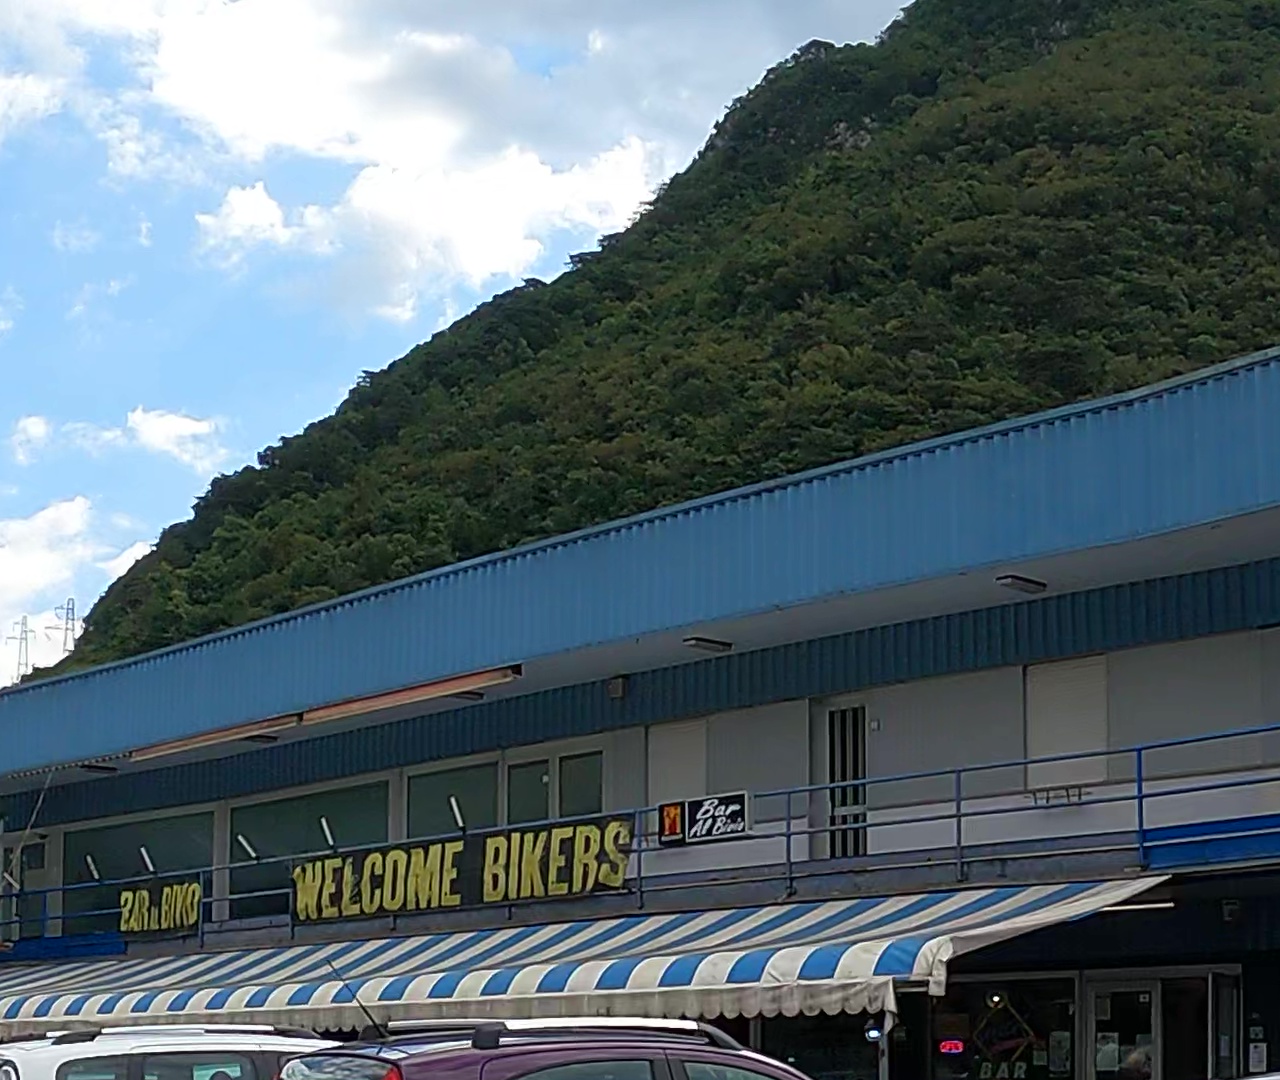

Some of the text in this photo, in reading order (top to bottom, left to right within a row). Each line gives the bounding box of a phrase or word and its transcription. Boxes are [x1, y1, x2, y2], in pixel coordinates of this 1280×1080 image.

[696, 799, 741, 820] Bar
[689, 818, 713, 837] Al
[292, 821, 631, 921] WELCOME BIKERS
[120, 889, 150, 931] BAR
[980, 1062, 1027, 1079] BAR
